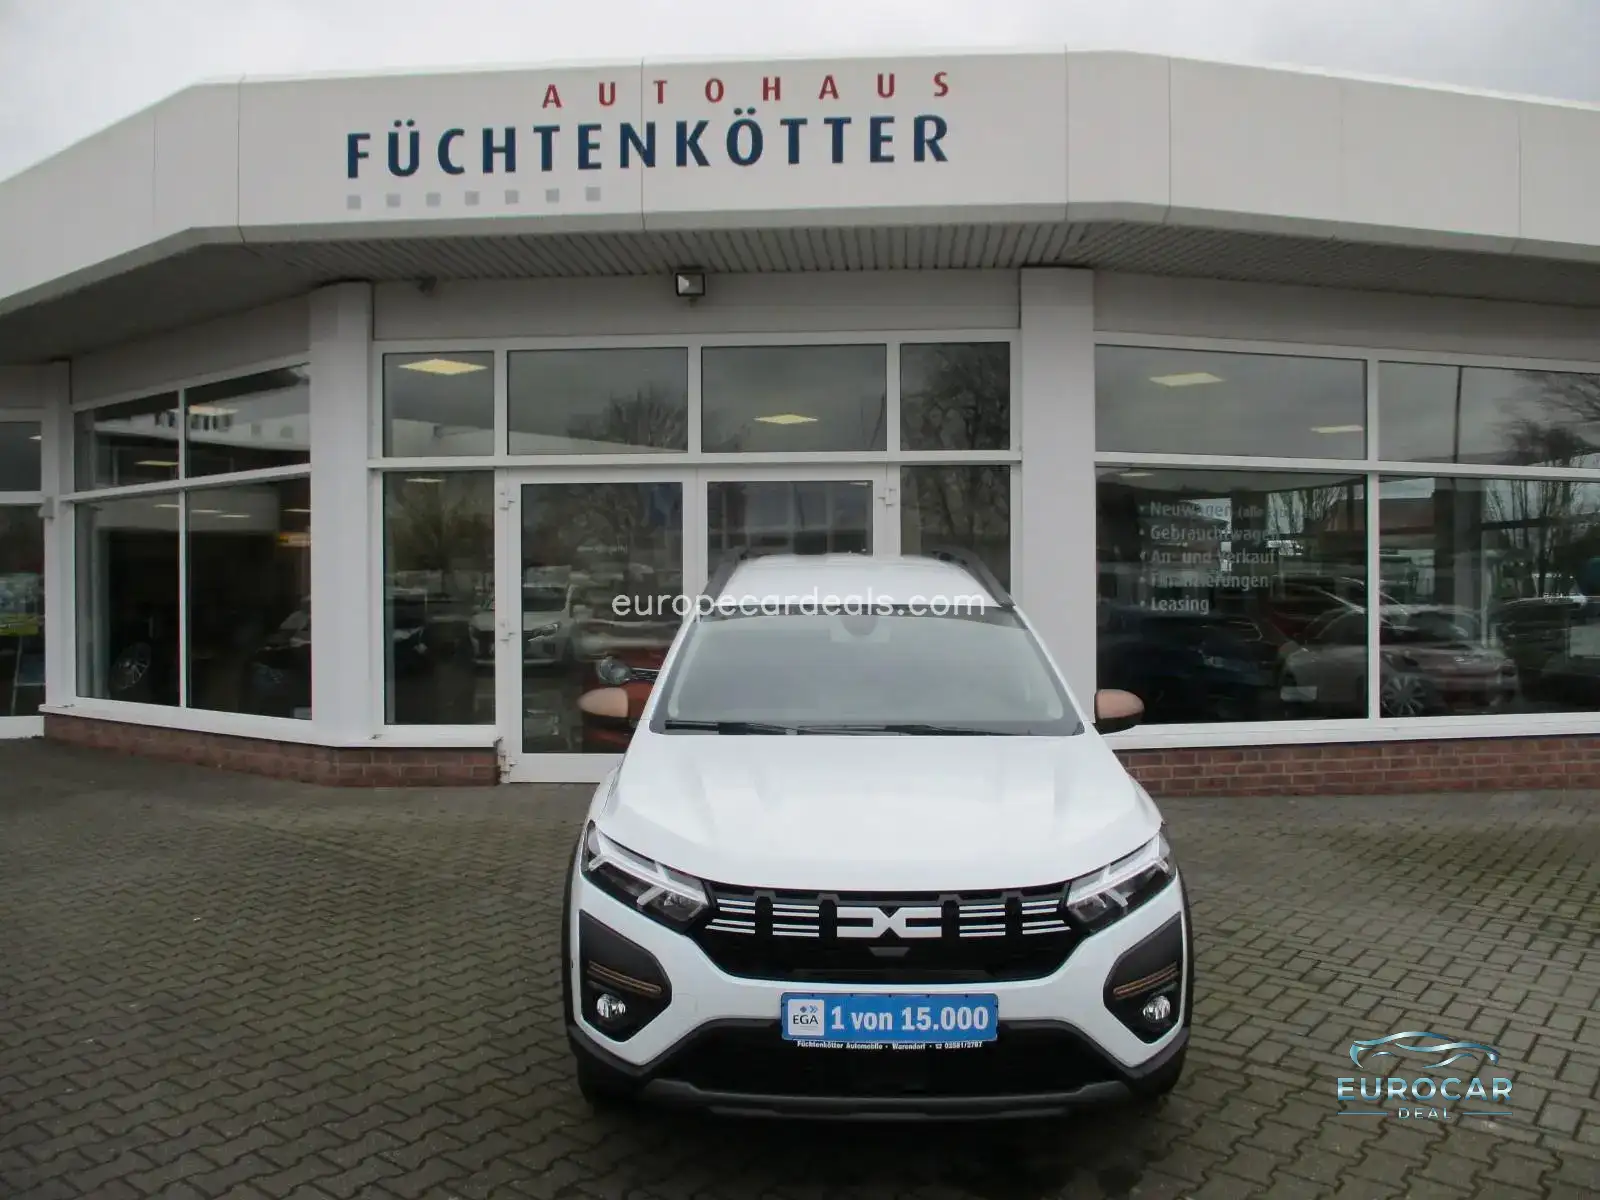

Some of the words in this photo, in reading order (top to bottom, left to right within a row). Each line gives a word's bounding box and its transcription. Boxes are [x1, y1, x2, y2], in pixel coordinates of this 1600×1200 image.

[541, 71, 951, 109] AUTOHAUS
[346, 107, 950, 179] FÜCHTENKÖTTER
[1183, 549, 1212, 565] und
[1151, 595, 1210, 615] Leasing
[792, 1014, 819, 1026] EGA
[831, 1006, 845, 1030] 1
[851, 1011, 893, 1031] von
[901, 1006, 989, 1031] 15.000
